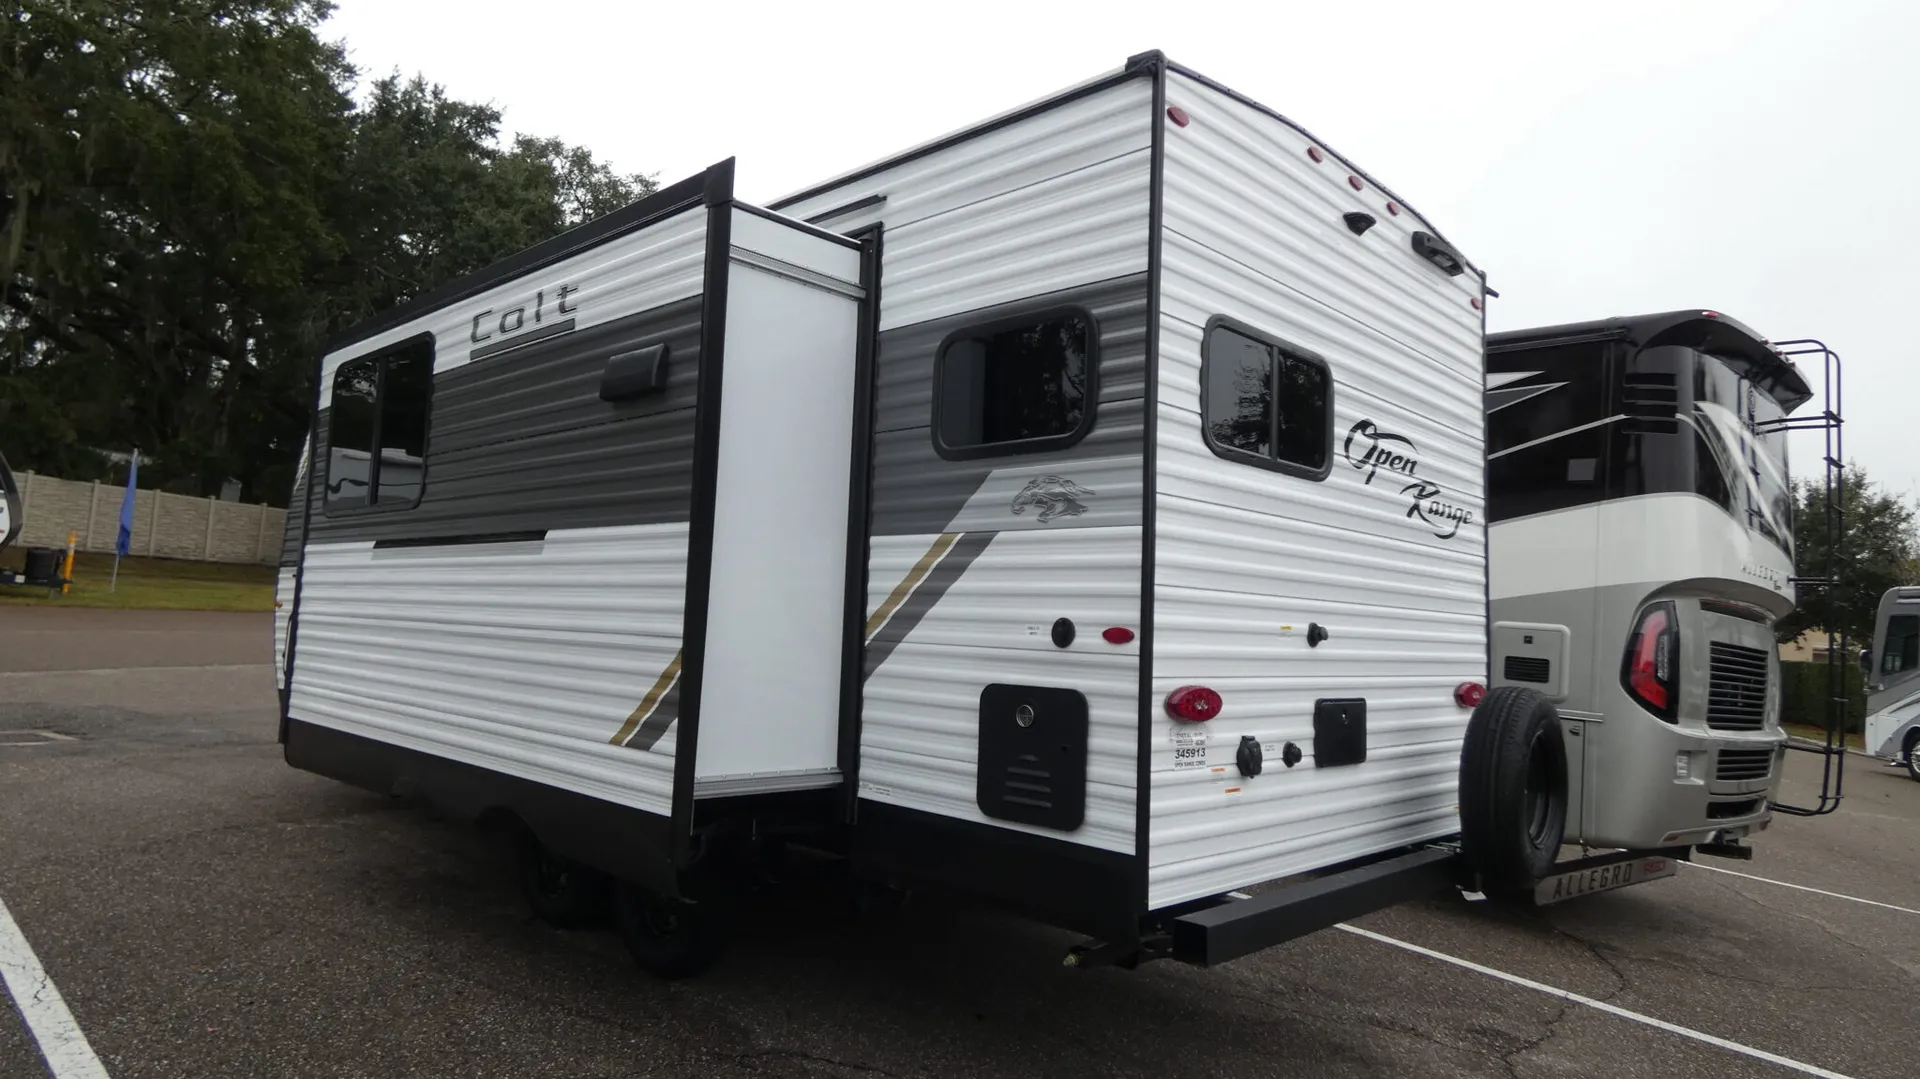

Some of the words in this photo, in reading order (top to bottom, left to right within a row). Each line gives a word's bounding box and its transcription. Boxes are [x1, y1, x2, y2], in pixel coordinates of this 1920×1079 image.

[471, 286, 577, 343] Colt
[1344, 419, 1418, 485] Open
[1400, 479, 1473, 540] Range
[1174, 747, 1206, 760] 345913
[1553, 862, 1633, 900] ALLEGRO
